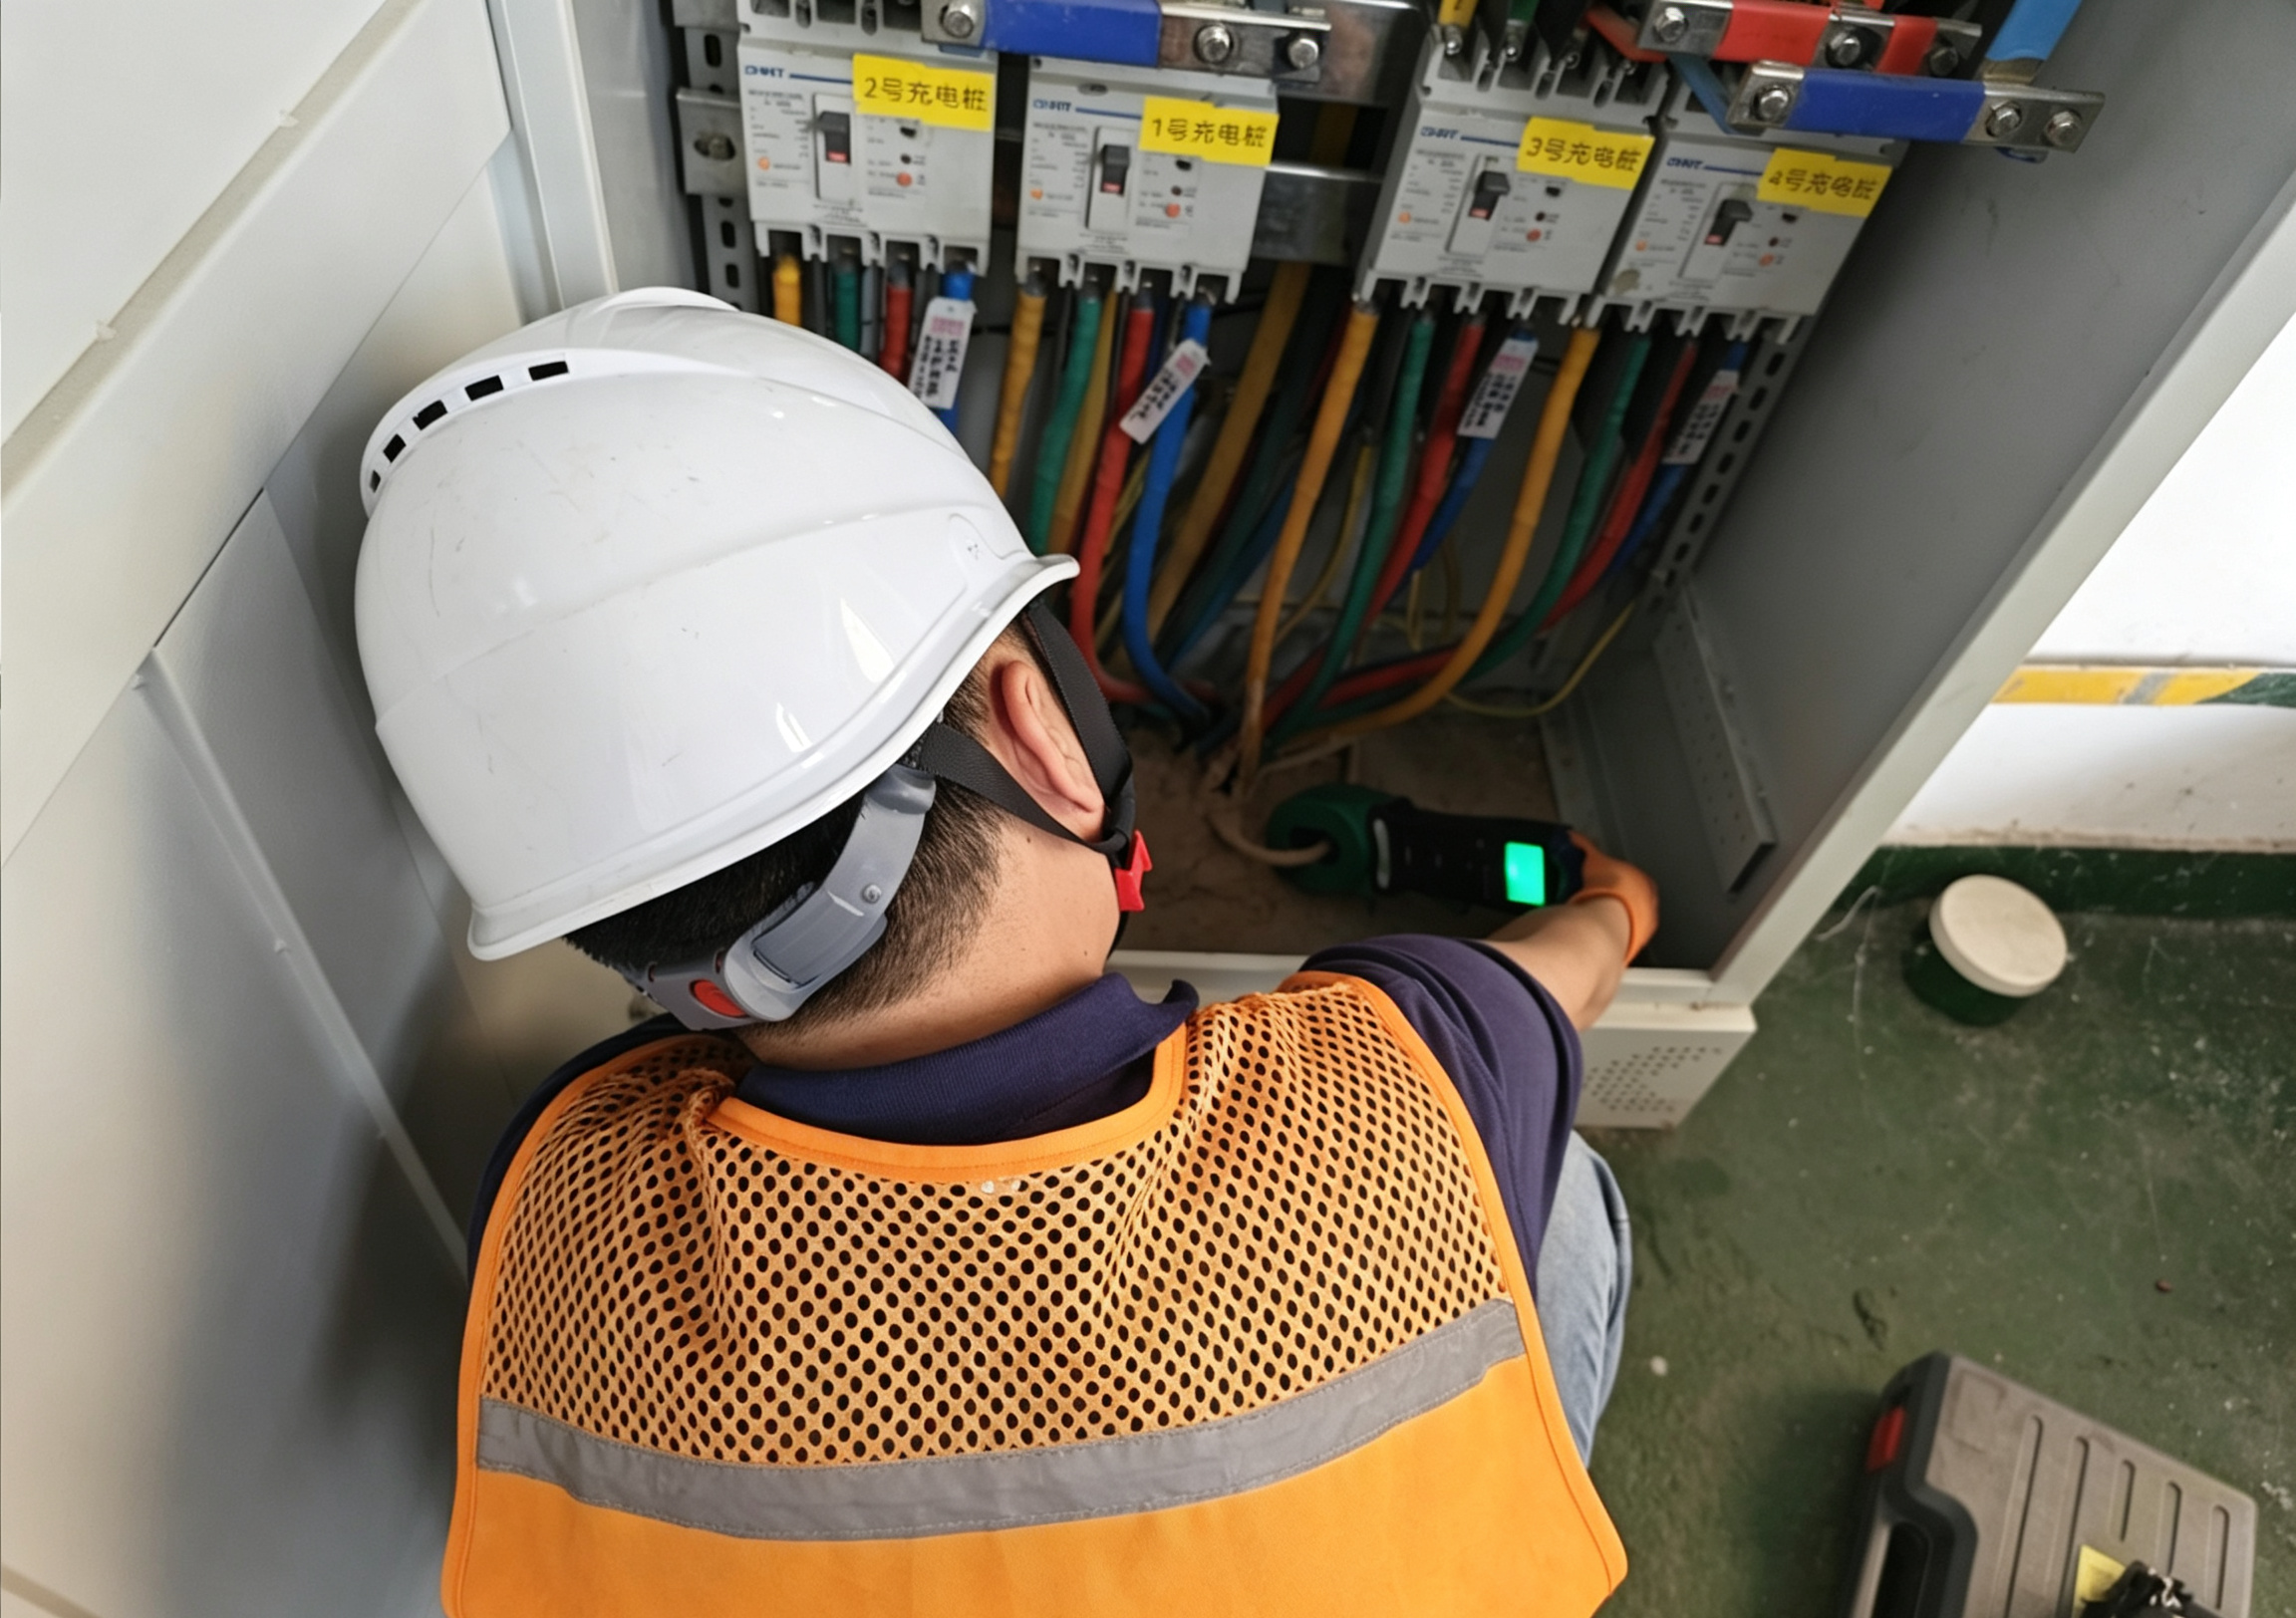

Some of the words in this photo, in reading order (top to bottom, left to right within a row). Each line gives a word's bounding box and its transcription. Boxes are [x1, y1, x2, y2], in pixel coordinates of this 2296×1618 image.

[863, 77, 989, 113] 2号充电桩
[1152, 118, 1269, 147] 1号充电桩
